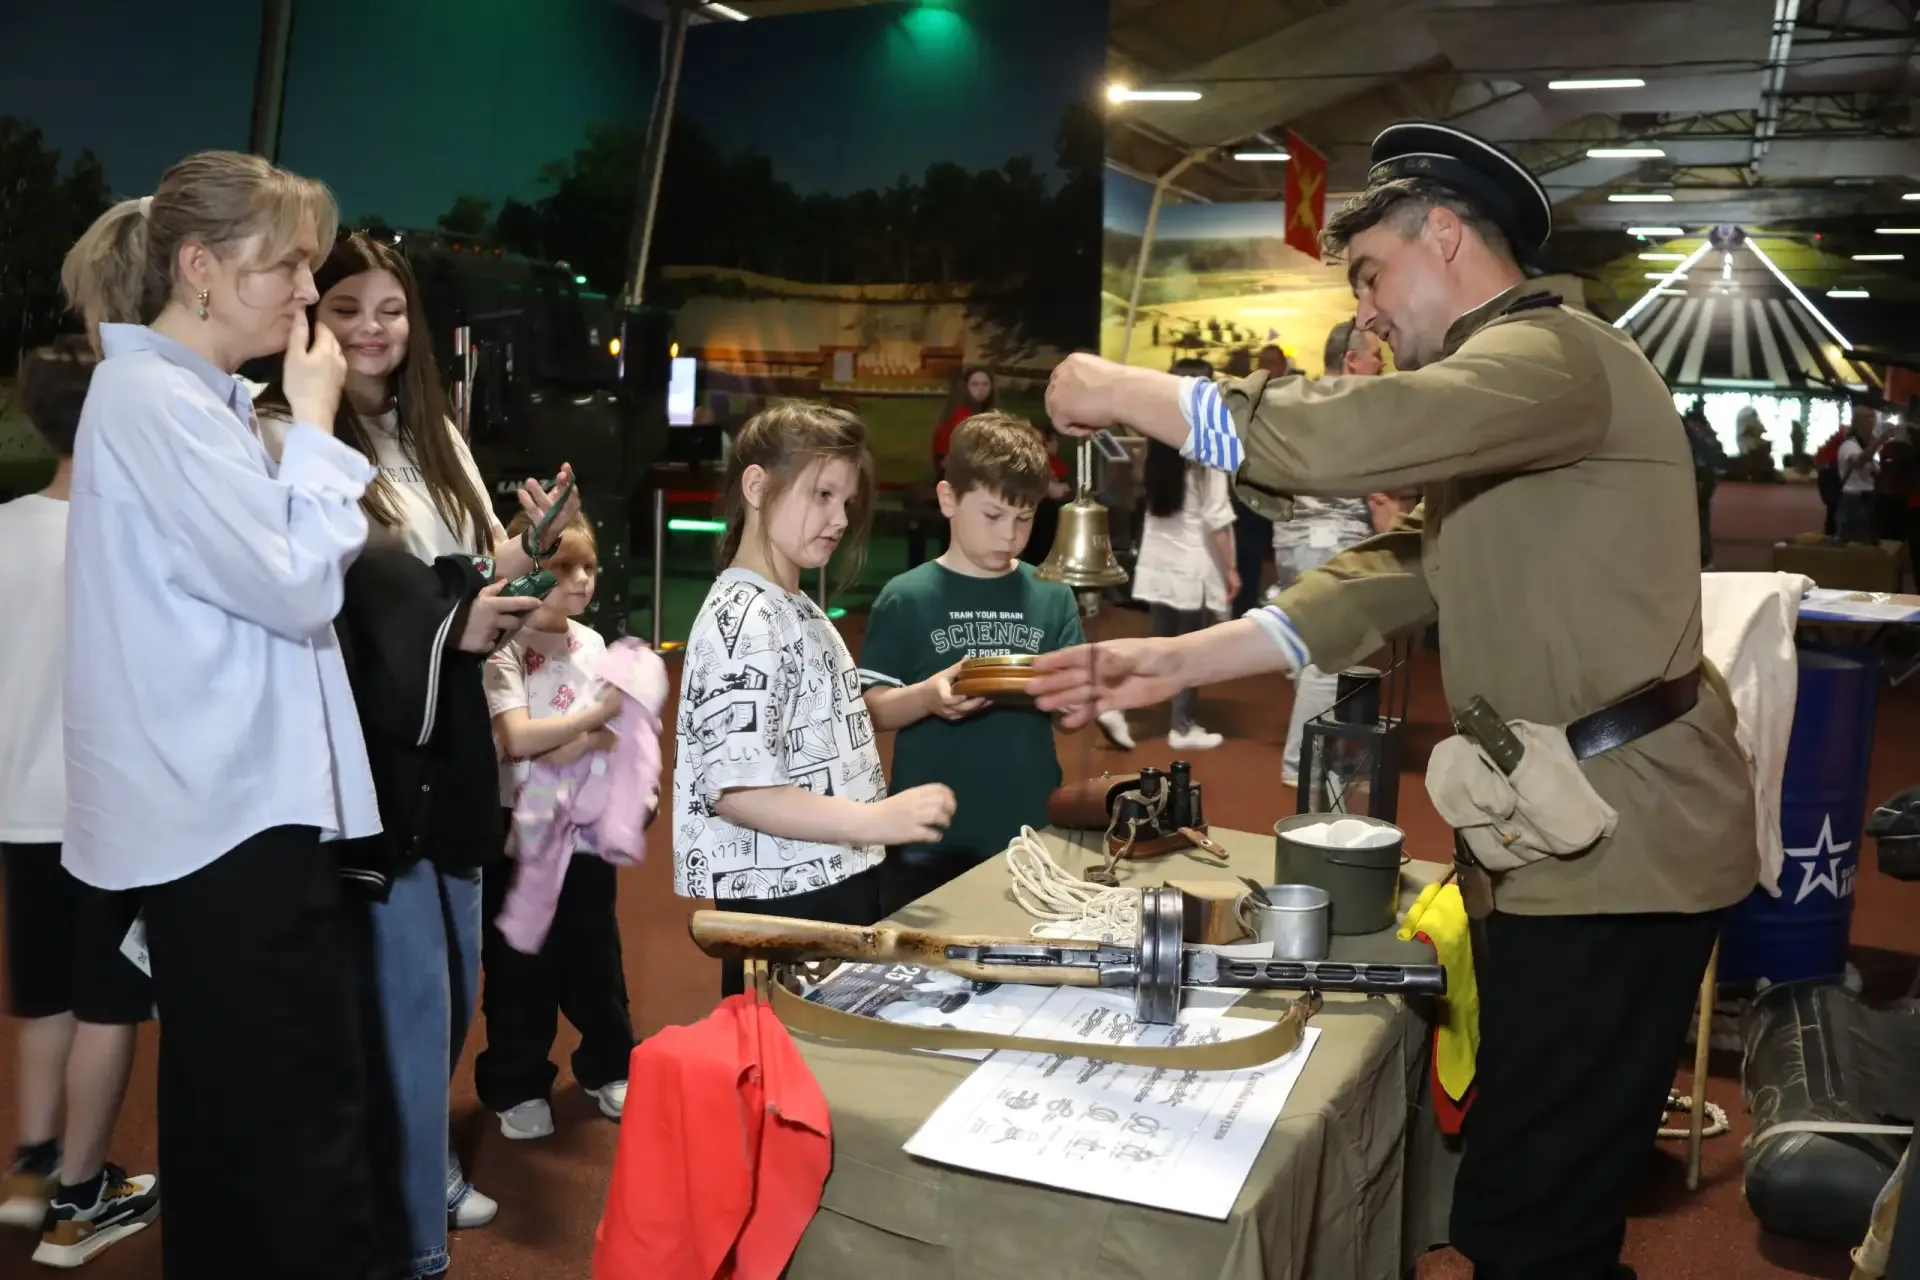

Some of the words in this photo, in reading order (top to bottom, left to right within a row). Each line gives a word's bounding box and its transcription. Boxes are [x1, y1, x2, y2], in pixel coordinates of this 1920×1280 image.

[949, 611, 973, 620] TRAIN
[976, 611, 997, 619] YOUR
[1000, 612, 1024, 620] BRAIN
[930, 621, 1045, 654] SCIENCE
[967, 648, 977, 658] IS
[979, 648, 1011, 658] POWER
[885, 964, 921, 983] 25
